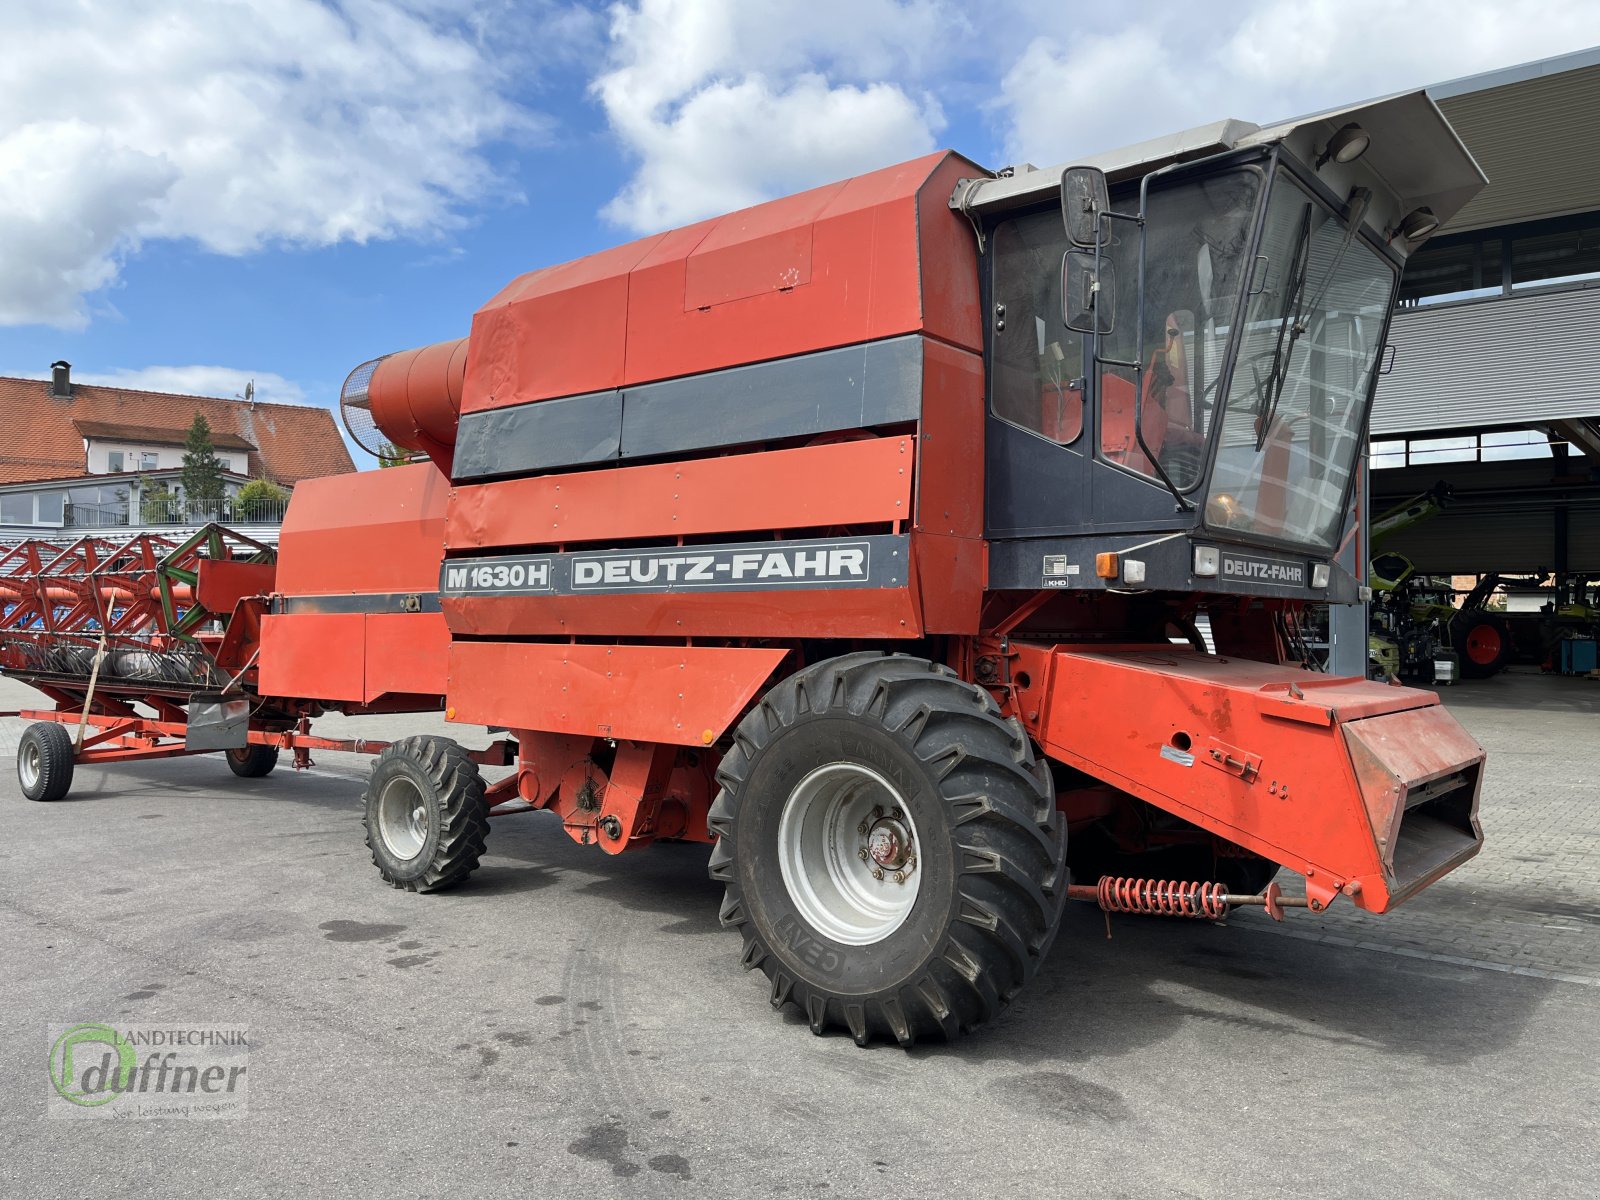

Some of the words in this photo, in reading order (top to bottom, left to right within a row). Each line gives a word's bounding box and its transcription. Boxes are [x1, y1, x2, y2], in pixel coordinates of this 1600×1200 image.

[447, 568, 467, 588] M
[471, 565, 525, 587] 1630
[528, 564, 547, 585] H
[575, 549, 863, 584] DEUTZ-FAHR
[1224, 559, 1302, 581] DEUTZ-FAHR
